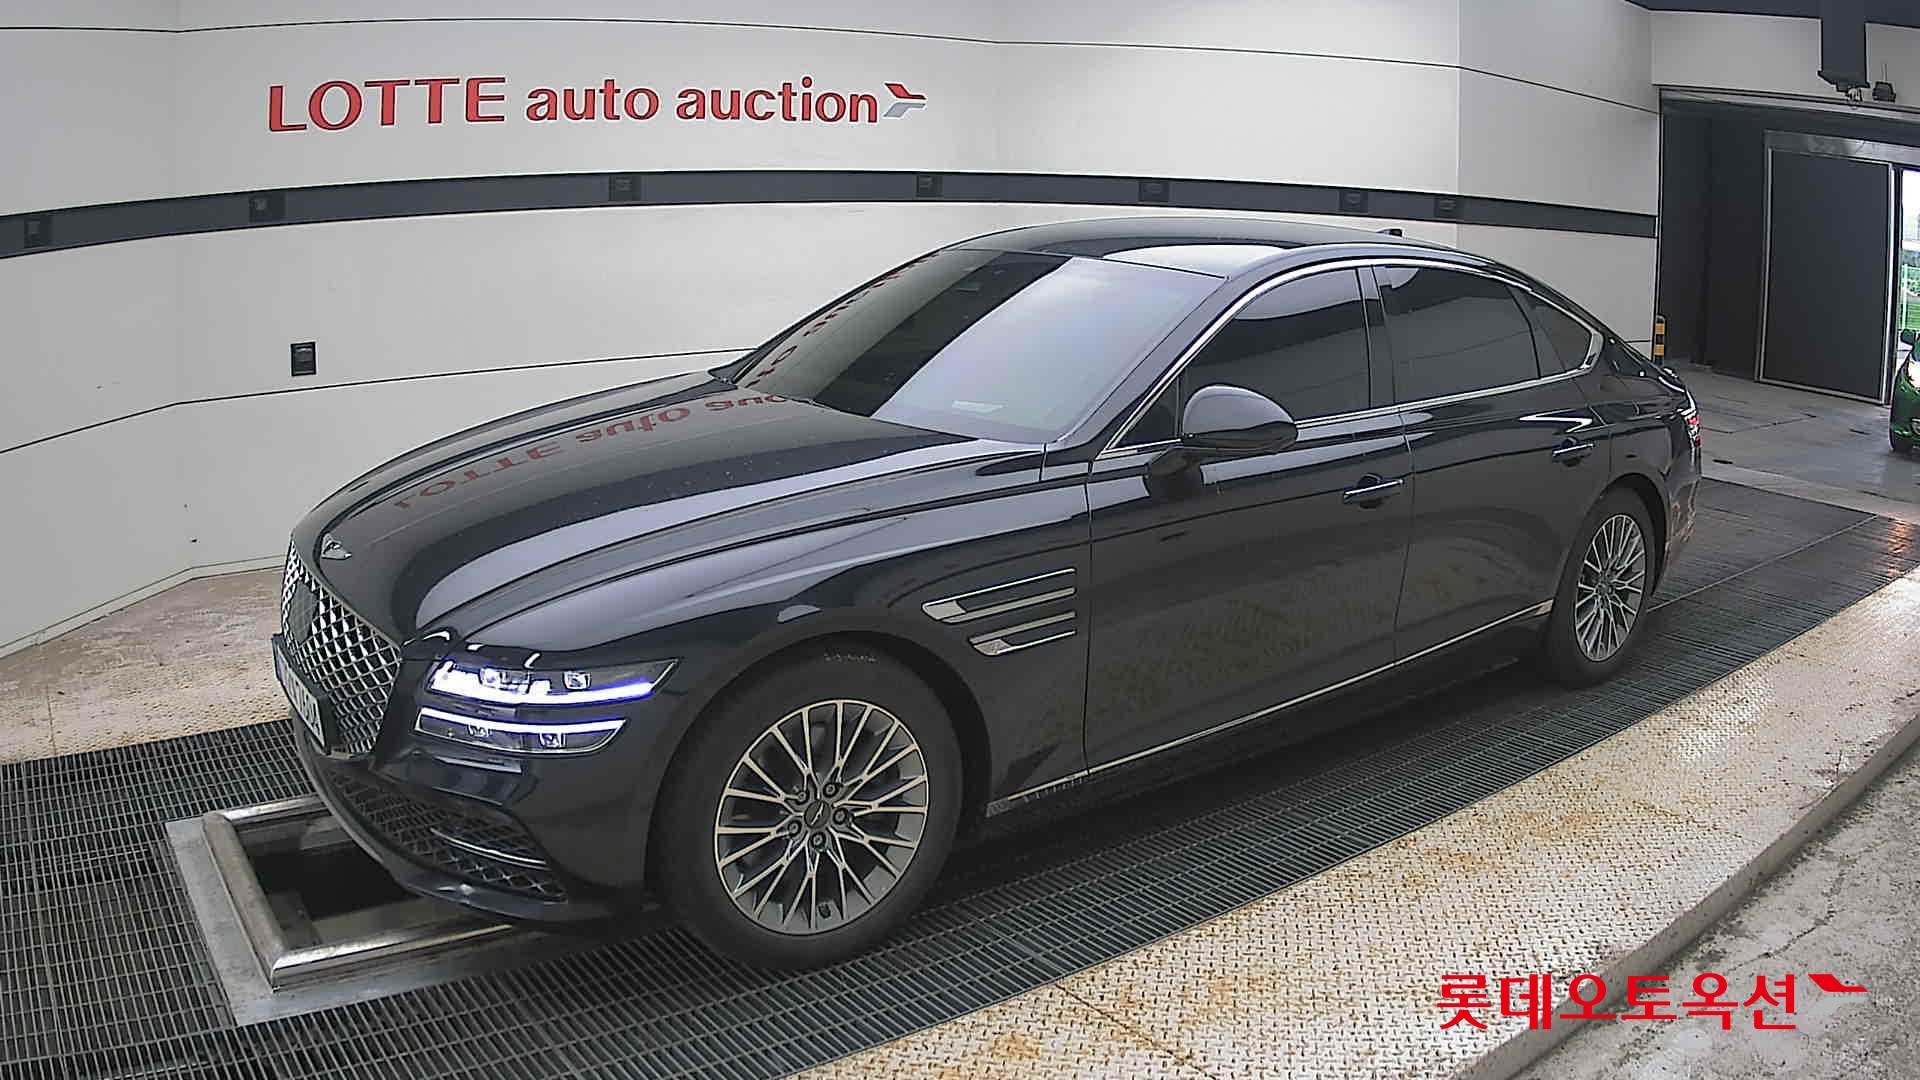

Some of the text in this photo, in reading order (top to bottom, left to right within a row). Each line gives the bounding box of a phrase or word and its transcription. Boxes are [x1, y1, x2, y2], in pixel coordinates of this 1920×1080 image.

[268, 75, 879, 133] LOTTE auto auction
